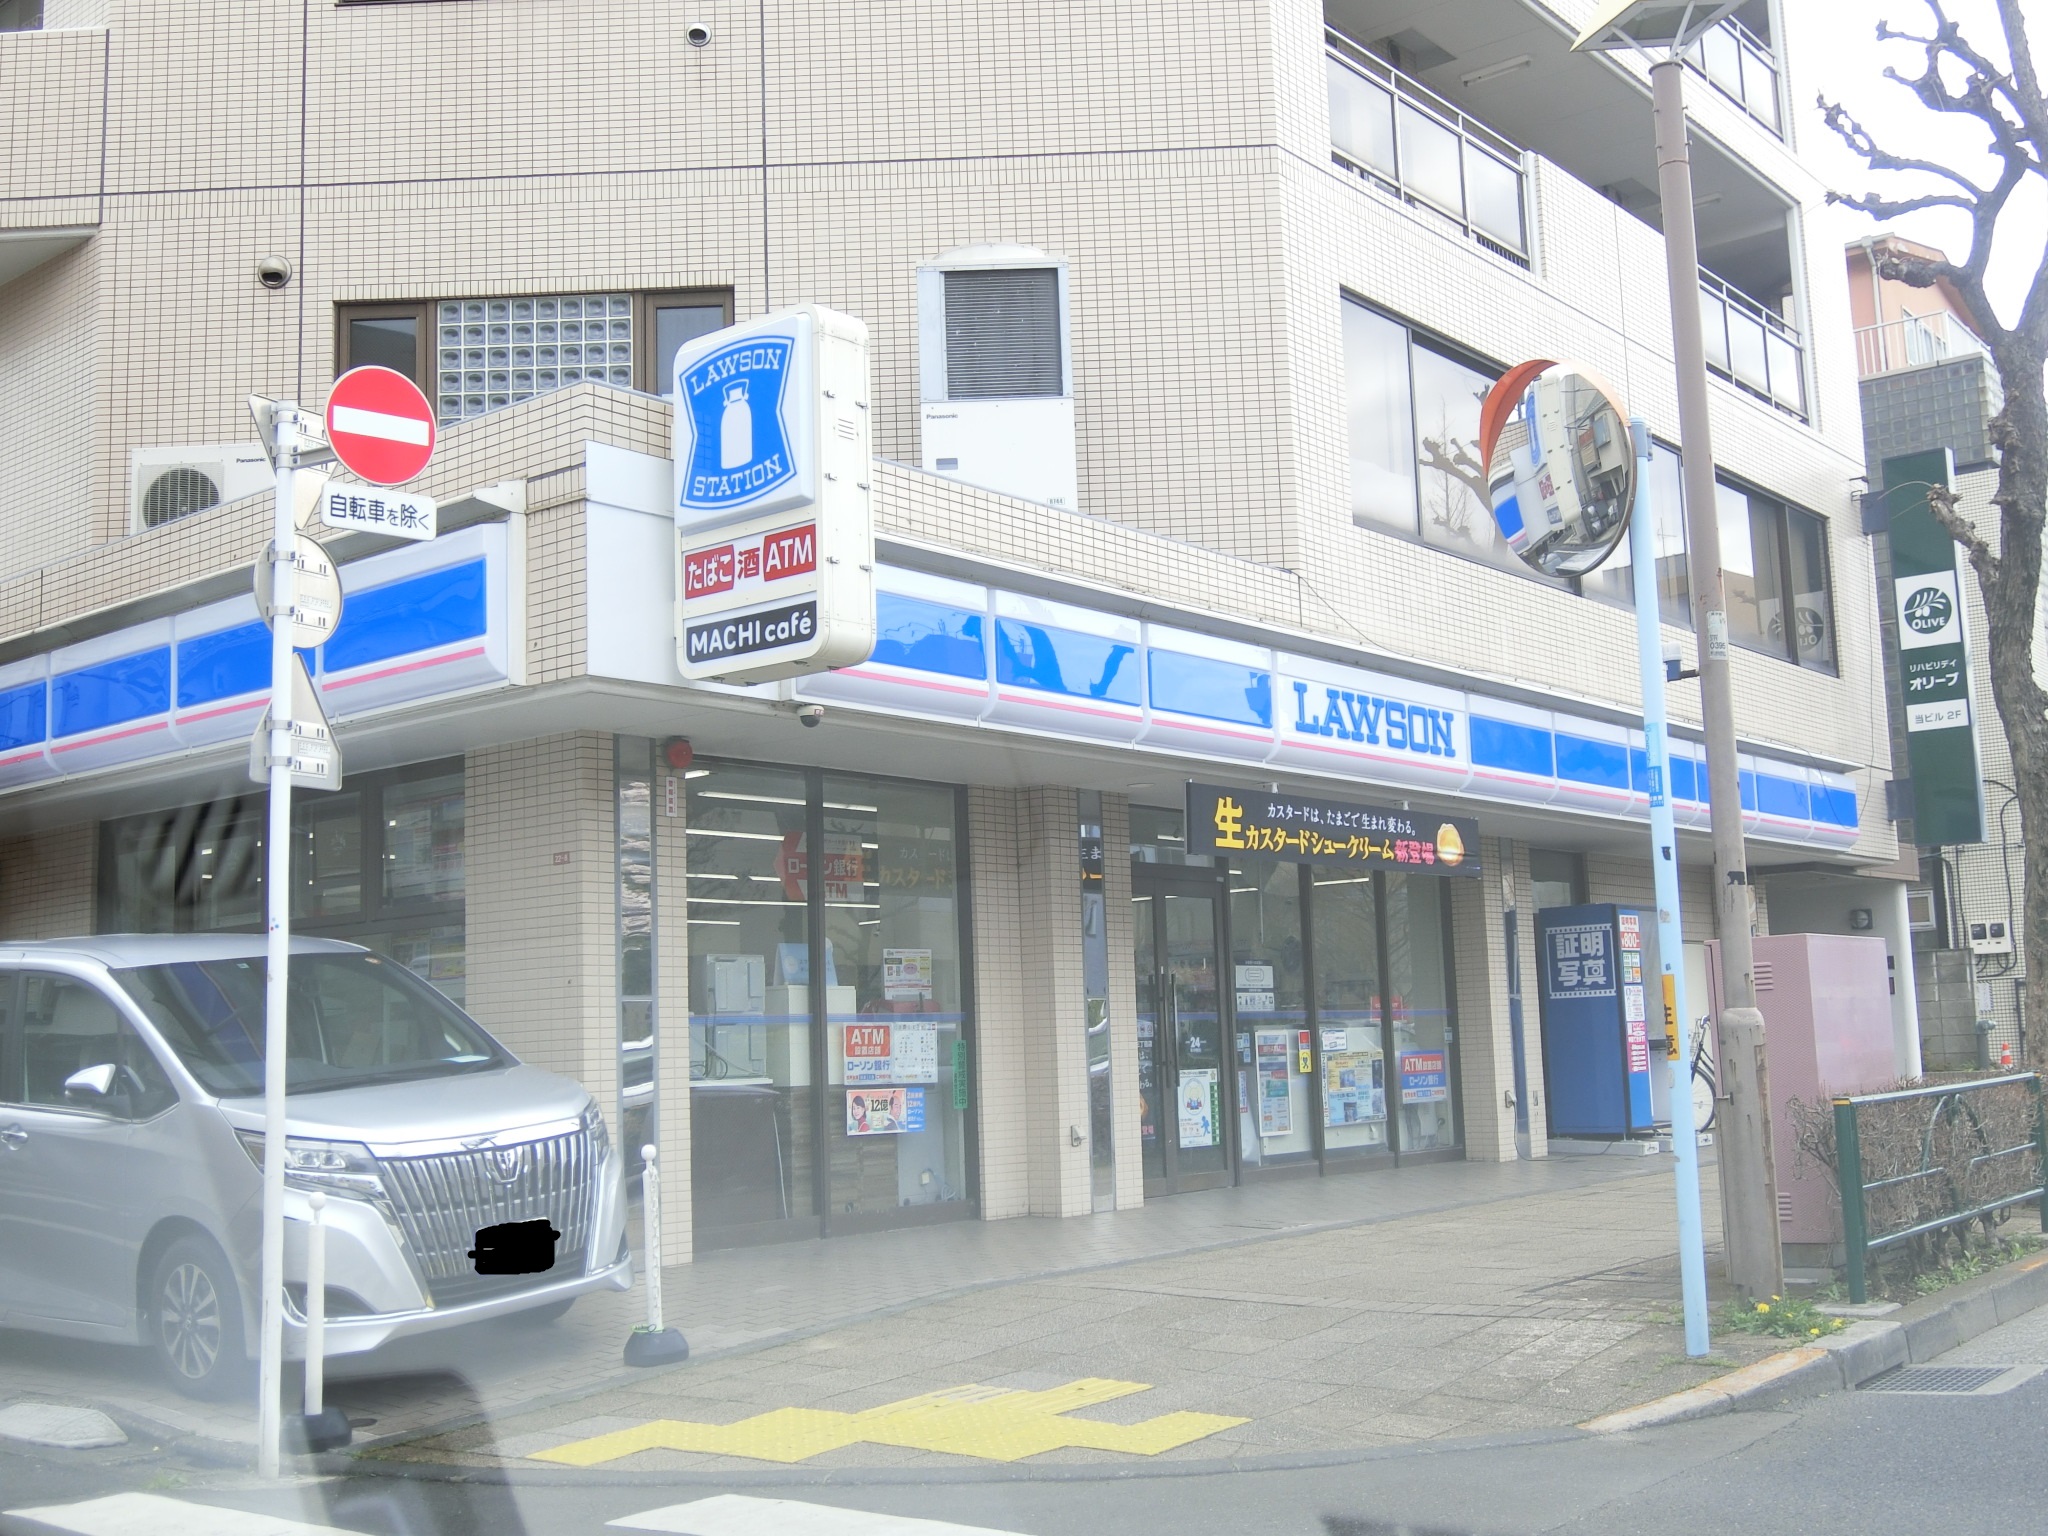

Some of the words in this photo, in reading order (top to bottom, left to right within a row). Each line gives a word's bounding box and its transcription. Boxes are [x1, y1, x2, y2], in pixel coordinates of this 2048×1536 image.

[690, 348, 782, 396] LAWSON
[926, 412, 958, 420] Panasonic
[693, 453, 783, 497] STATION
[330, 492, 430, 531] 自転車を除く
[688, 554, 733, 591] たばこ
[737, 547, 760, 580] 酒
[765, 533, 813, 573] ATM
[691, 619, 760, 657] MACHI
[764, 609, 812, 643] café
[1912, 616, 1946, 630] OLIVE
[1909, 658, 1958, 673] リハビリデイ
[1909, 672, 1960, 691] オリーブ
[1293, 680, 1456, 758] LAWSON
[1914, 712, 1944, 725] 当ビル
[1946, 709, 1962, 721] 2F
[1214, 796, 1246, 850] 生
[1245, 824, 1395, 862] カスタードシュークリーム
[1394, 838, 1435, 866] 新登場
[788, 858, 859, 878] ローン銀行
[825, 881, 848, 899] TM
[1555, 931, 1605, 960] 証明
[1557, 960, 1608, 987] 写真
[850, 1028, 885, 1045] ATM
[847, 1060, 890, 1071] ローソン銀行
[870, 1098, 889, 1112] 12億
